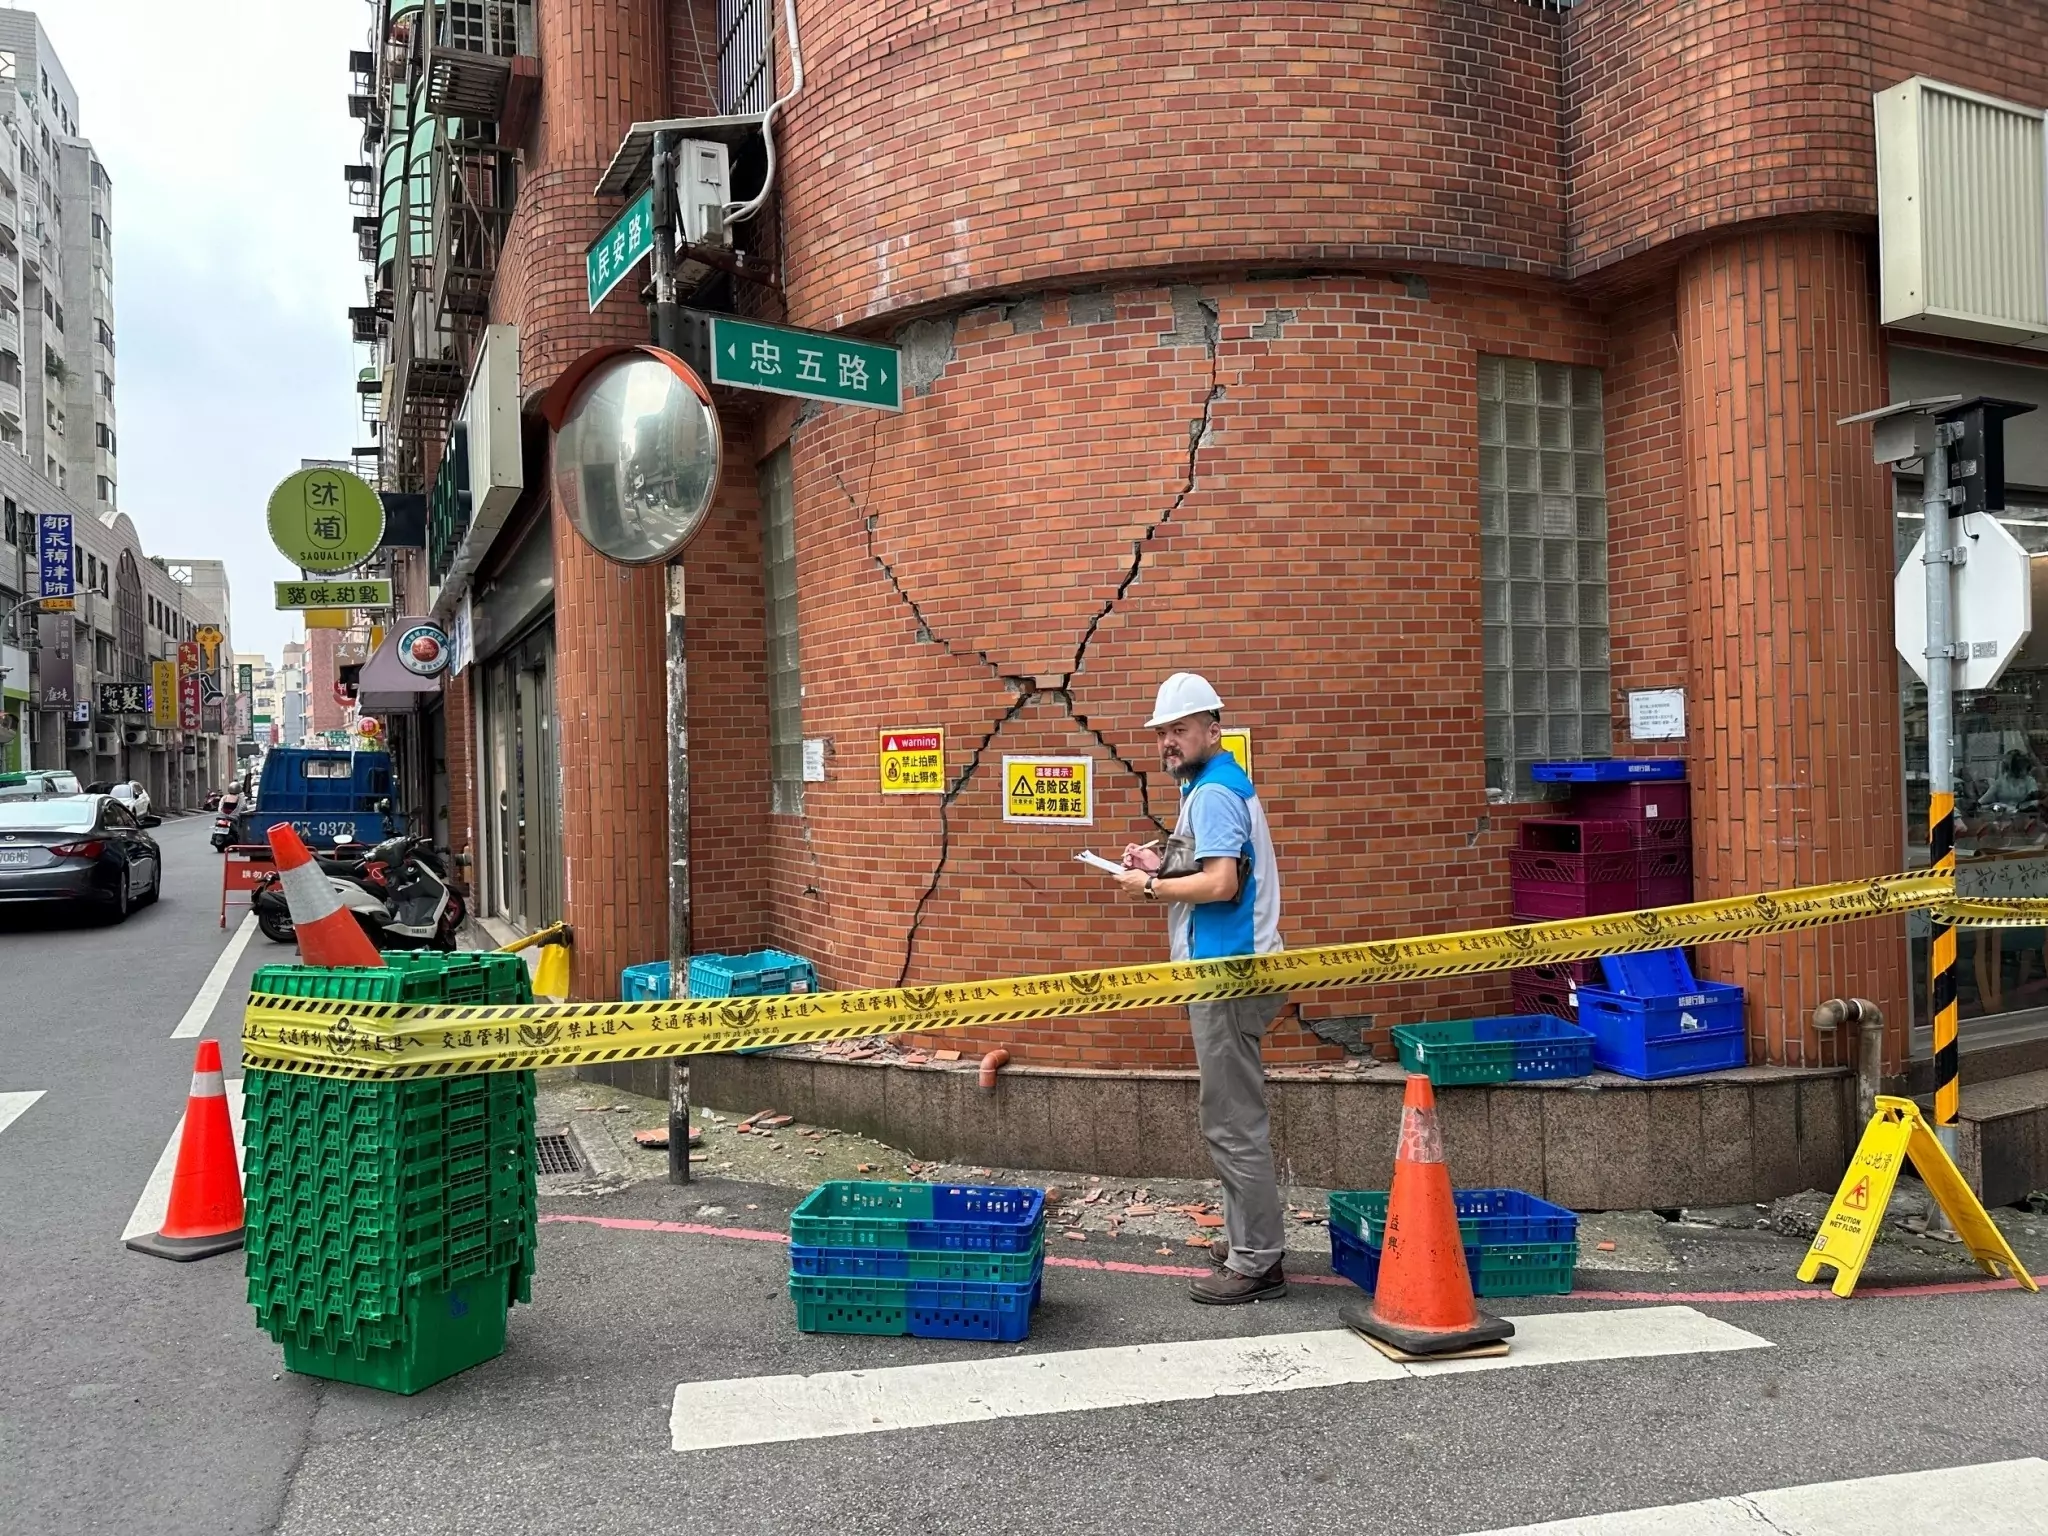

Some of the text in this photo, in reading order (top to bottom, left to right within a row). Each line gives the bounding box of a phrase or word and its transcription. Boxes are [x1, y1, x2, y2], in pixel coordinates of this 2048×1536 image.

[598, 213, 641, 286] 民安路
[750, 339, 870, 391] 忠五路
[300, 551, 359, 561] SAQUALITY
[336, 645, 366, 658] 美味
[901, 736, 937, 749] warning
[902, 755, 937, 767] 禁止拍照
[902, 771, 938, 784] 禁止摄像
[1035, 779, 1081, 794] 危险区域
[1035, 798, 1081, 812] 请勿靠近
[278, 1028, 322, 1047] 交通管制
[360, 1034, 425, 1051] 禁止進入
[442, 1027, 510, 1049] 交通管制
[567, 1018, 634, 1039] 禁止進入
[650, 1011, 713, 1031] 交通管制
[765, 1003, 826, 1021] 禁止進入
[840, 995, 898, 1013] 交通管制
[944, 987, 999, 1003] 禁止進入
[1012, 980, 1065, 997] 交通管制
[1108, 971, 1159, 987] 禁止進入
[1171, 964, 1221, 981] 交通管制
[1260, 957, 1308, 972] 禁止進入
[1319, 950, 1366, 966] 交通管制
[1402, 941, 1449, 957] 禁止進入
[1459, 936, 1505, 951] 交通管制
[1537, 928, 1582, 943] 禁止進入
[1590, 921, 1633, 936] 交通管制
[1664, 914, 1706, 928] 禁止進入
[1713, 907, 1755, 922] 交通管制
[1783, 899, 1822, 914] 禁止進入
[1829, 895, 1865, 909] 交通管制
[497, 1045, 582, 1058] 桃園市政府警察局
[703, 1026, 779, 1040] 桃園市政府警察局
[889, 1009, 958, 1022] 桃園市政府警察局
[1059, 993, 1122, 1006] 桃園市政府警察局
[1836, 1213, 1861, 1225] CAUTION
[1830, 1220, 1861, 1234] WET FLOOR
